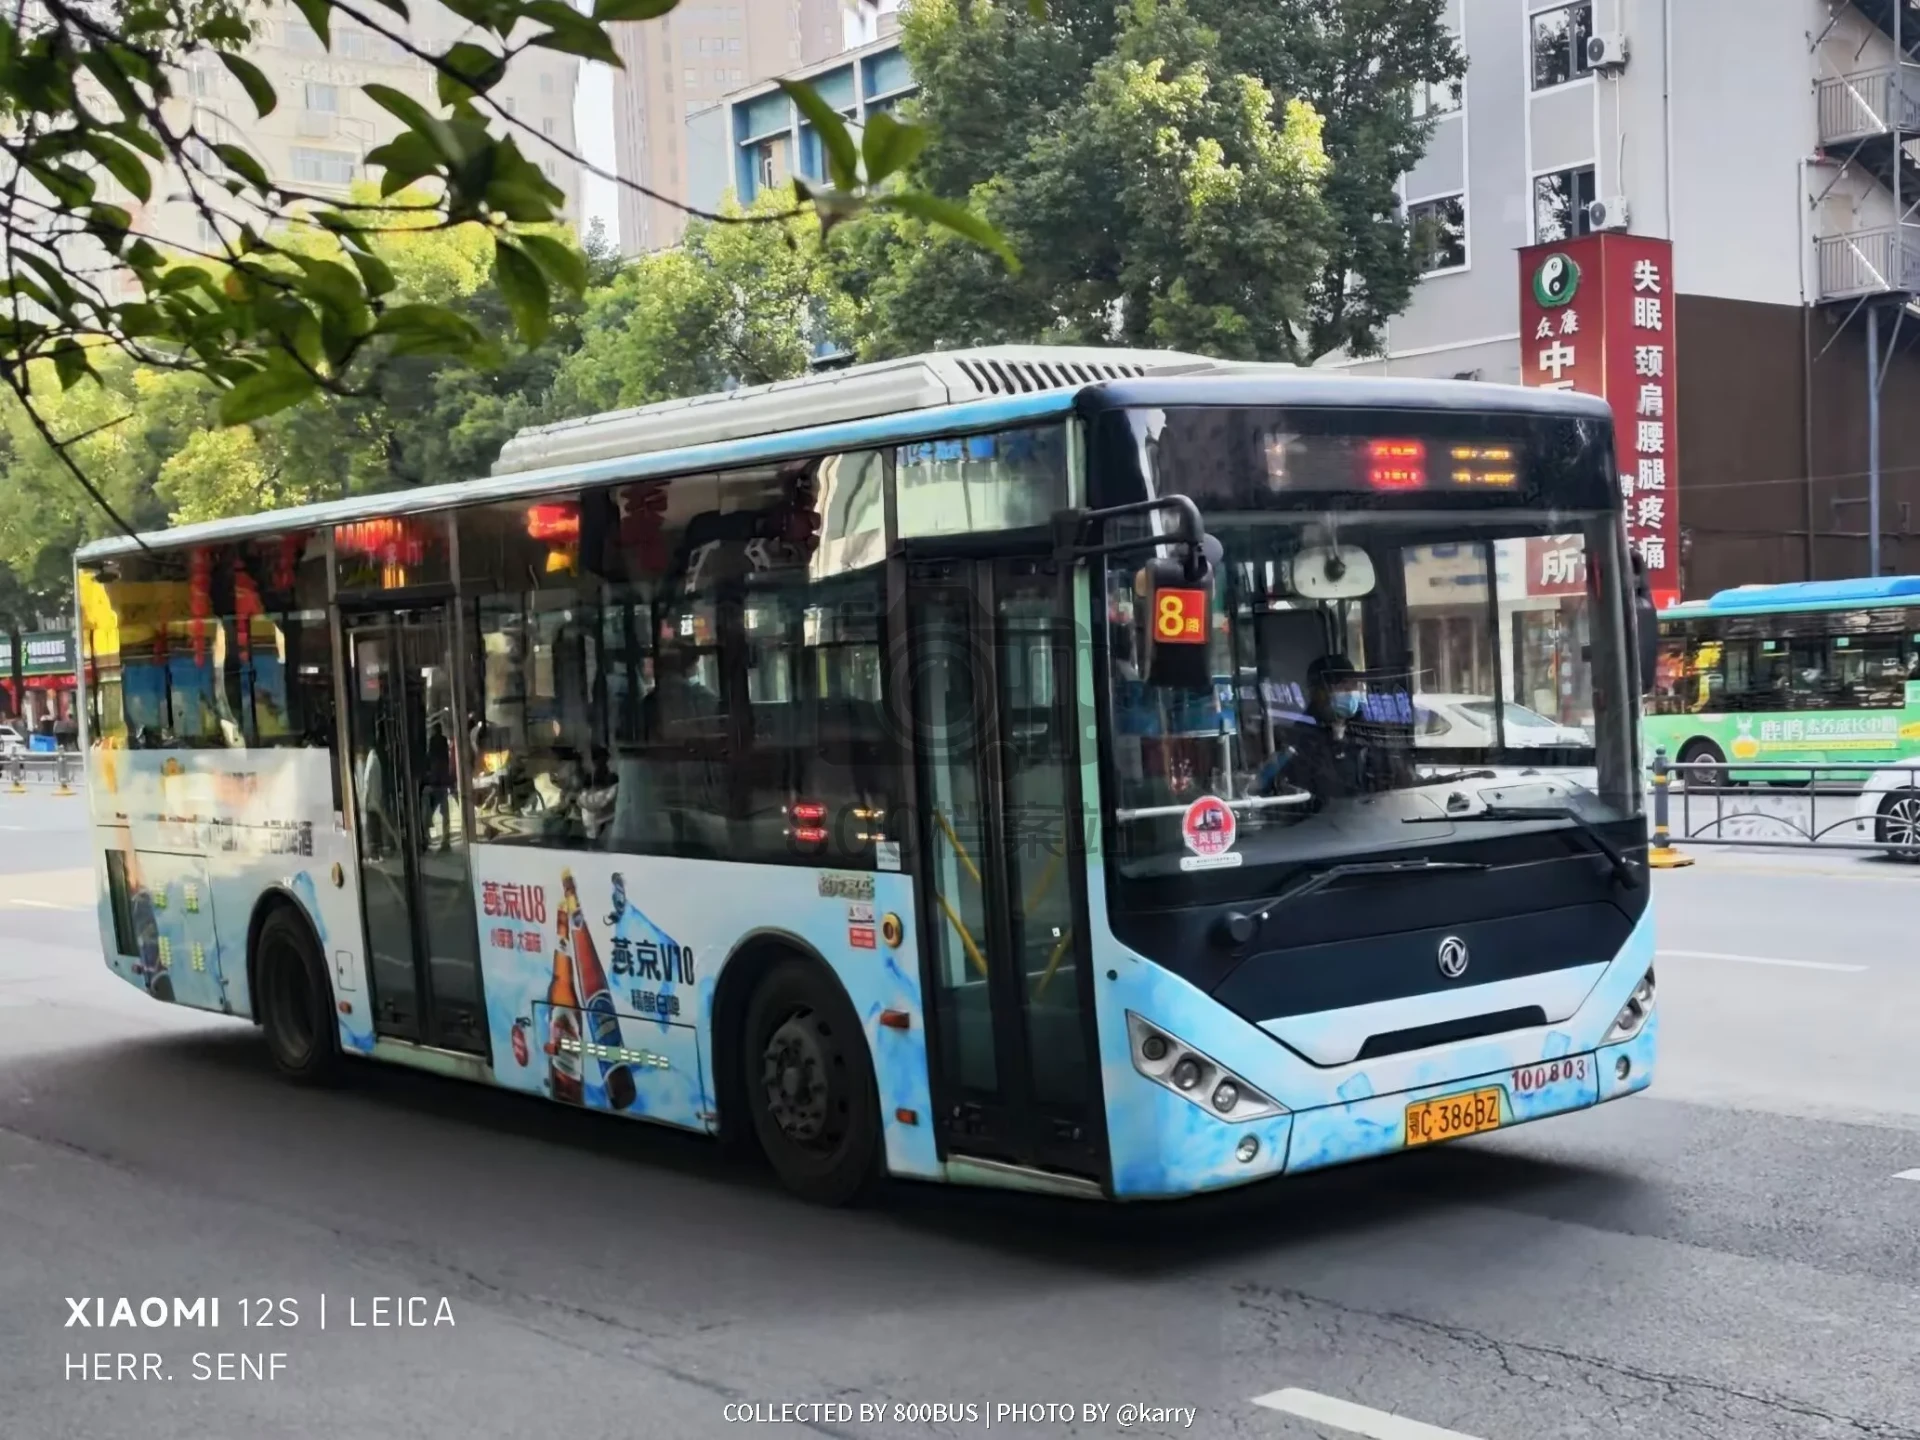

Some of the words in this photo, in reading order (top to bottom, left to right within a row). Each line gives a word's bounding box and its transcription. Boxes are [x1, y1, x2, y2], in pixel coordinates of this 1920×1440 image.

[1633, 258, 1662, 332] 失眠
[1535, 309, 1579, 340] 众康
[1634, 345, 1667, 569] 颈肩腰腿疼痛
[482, 880, 547, 925] 燕京U8
[610, 936, 695, 986] 燕京V10
[1511, 1059, 1585, 1092] 100803
